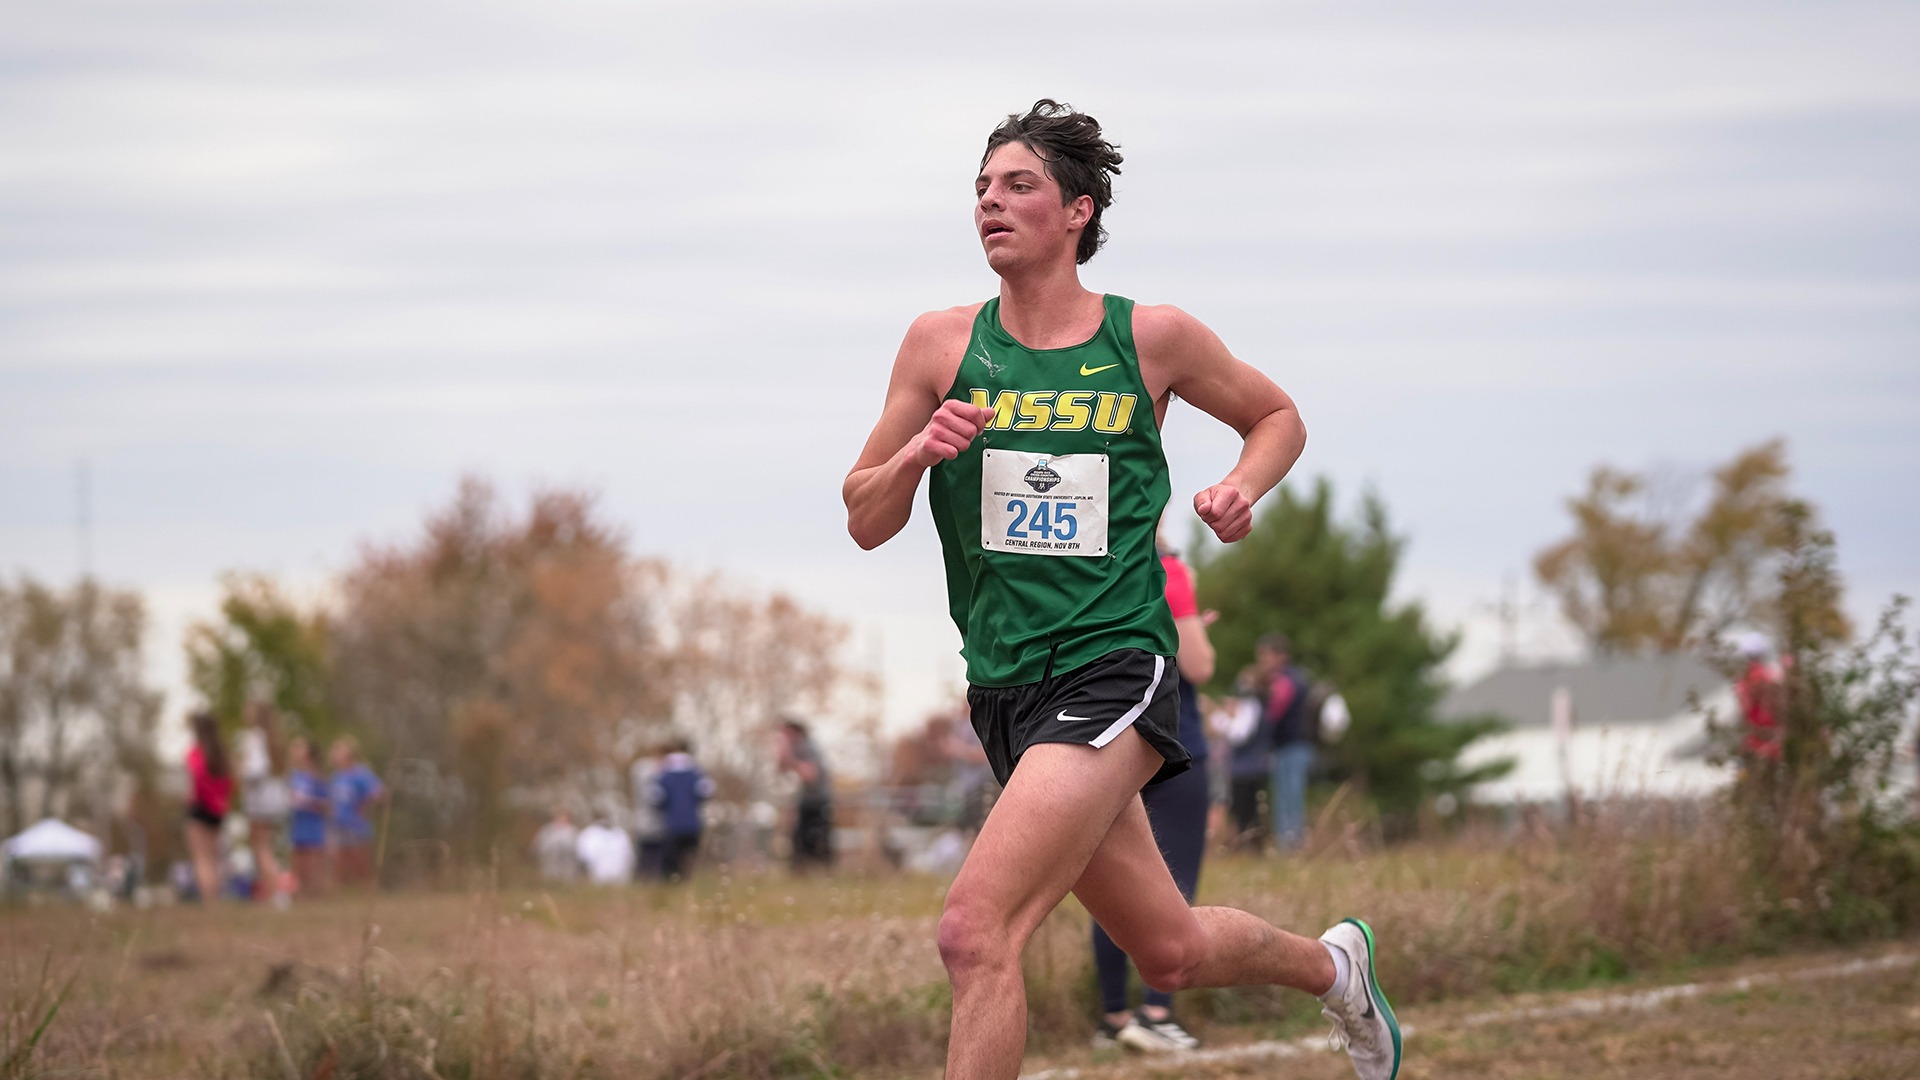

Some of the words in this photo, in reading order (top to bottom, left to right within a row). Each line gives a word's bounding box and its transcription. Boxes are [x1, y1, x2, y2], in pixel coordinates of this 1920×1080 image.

[969, 388, 1138, 435] MSSU
[1025, 475, 1060, 483] CHAMPIONSHIPS
[1006, 499, 1078, 541] 245
[1005, 539, 1028, 548] CENTRAL
[1030, 541, 1052, 549] REGION,
